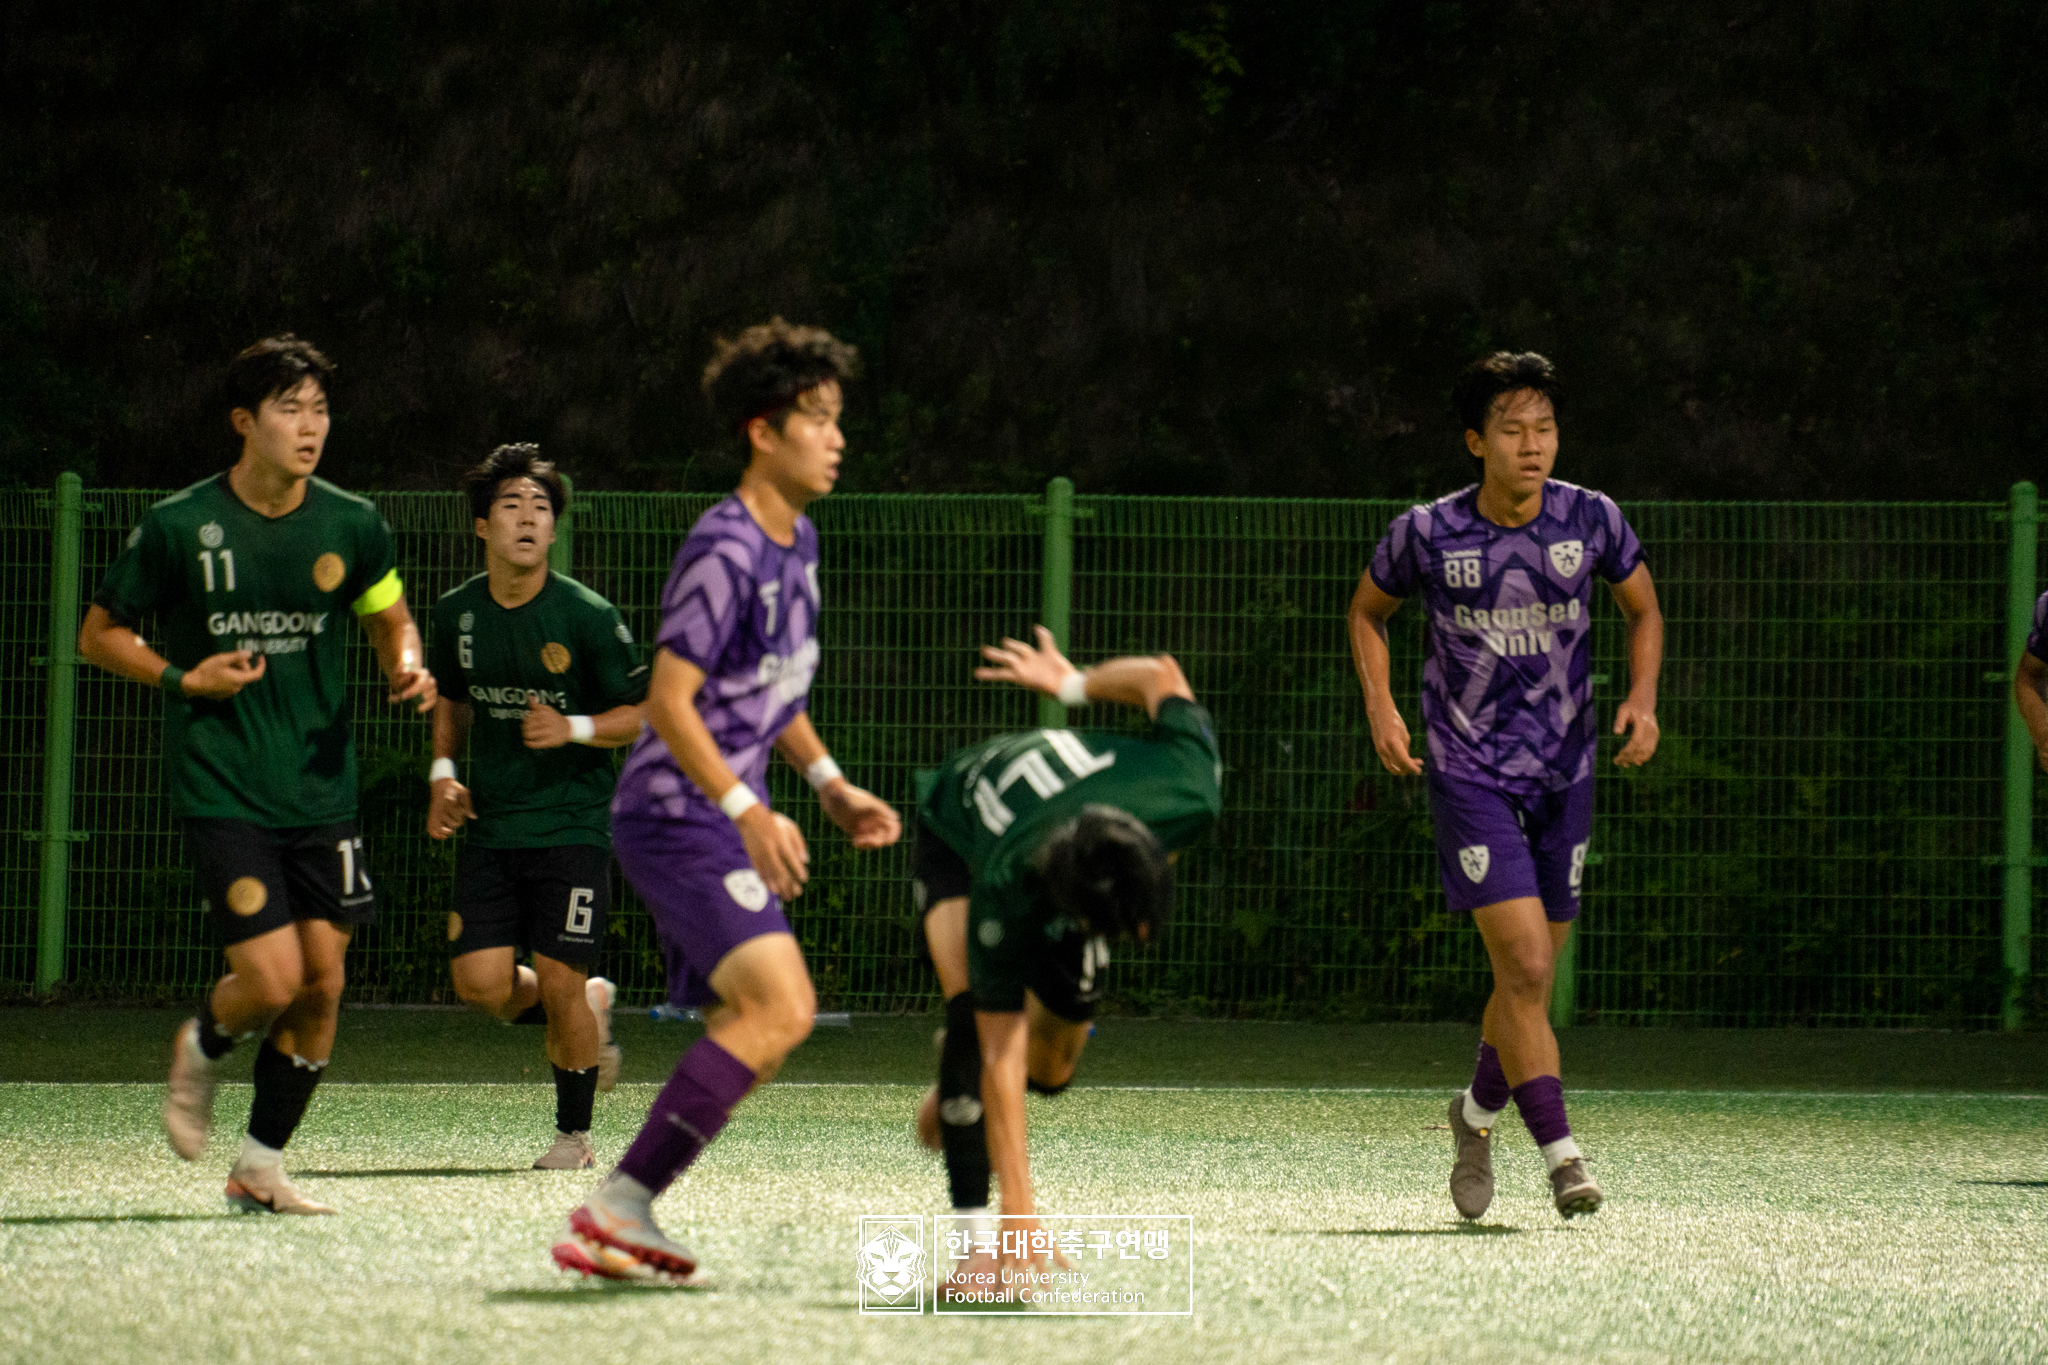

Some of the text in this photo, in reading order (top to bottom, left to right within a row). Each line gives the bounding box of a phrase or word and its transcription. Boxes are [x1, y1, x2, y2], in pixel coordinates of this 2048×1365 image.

[198, 550, 235, 592] 11
[1444, 558, 1482, 588] 88
[458, 635, 474, 669] 6
[565, 887, 593, 934] 6
